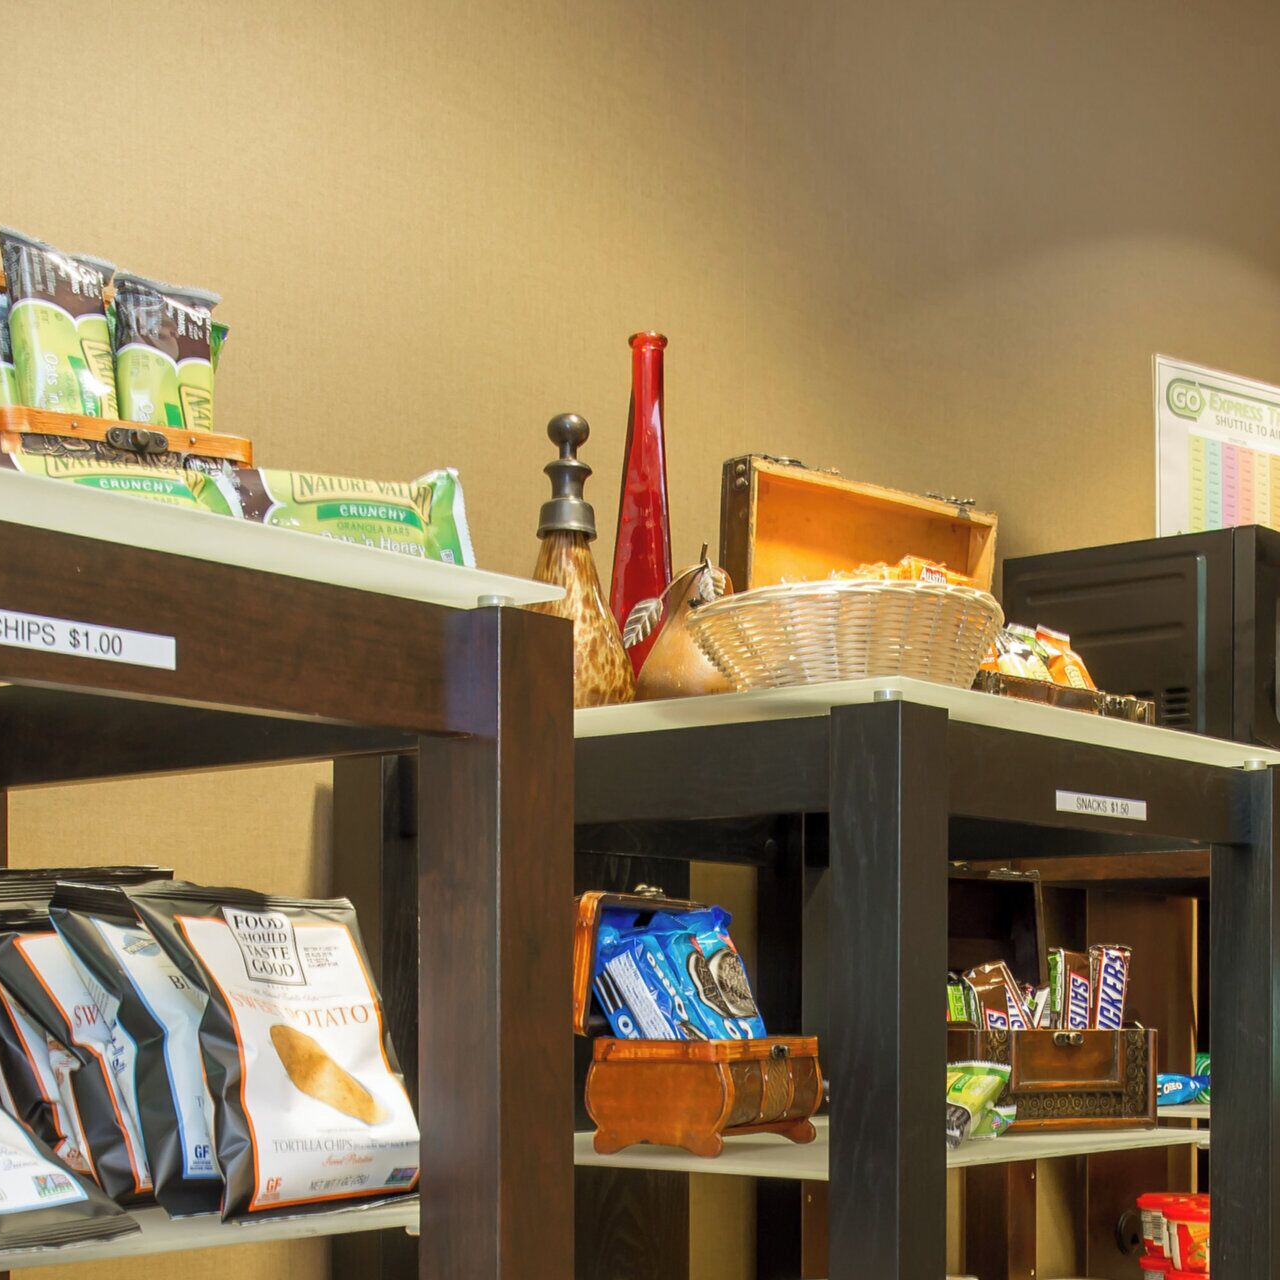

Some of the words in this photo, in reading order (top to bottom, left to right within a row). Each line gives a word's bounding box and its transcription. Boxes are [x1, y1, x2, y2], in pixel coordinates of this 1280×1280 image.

[1172, 387, 1201, 413] GO
[1209, 392, 1264, 423] EXPRESS
[1215, 414, 1254, 435] SHUTTLE
[1256, 425, 1268, 438] TO
[99, 477, 176, 494] CRUNCHY
[298, 473, 372, 497] NATURE
[339, 503, 407, 523] CRUNCHY
[337, 522, 382, 535] GRANOLA
[385, 525, 411, 538] BARS
[919, 566, 947, 584] Austin
[67, 625, 124, 658] $1.00
[1075, 796, 1108, 814] SNACKS
[233, 914, 284, 931] FOOD
[238, 931, 288, 944] SHOULD
[244, 944, 291, 961] TASTE
[251, 959, 295, 977] GOOD
[1162, 1081, 1184, 1096] OREO
[193, 1144, 210, 1160] GF
[273, 1139, 322, 1154] TORTILLA
[323, 1138, 354, 1152] CHIPS
[265, 1176, 283, 1192] GF
